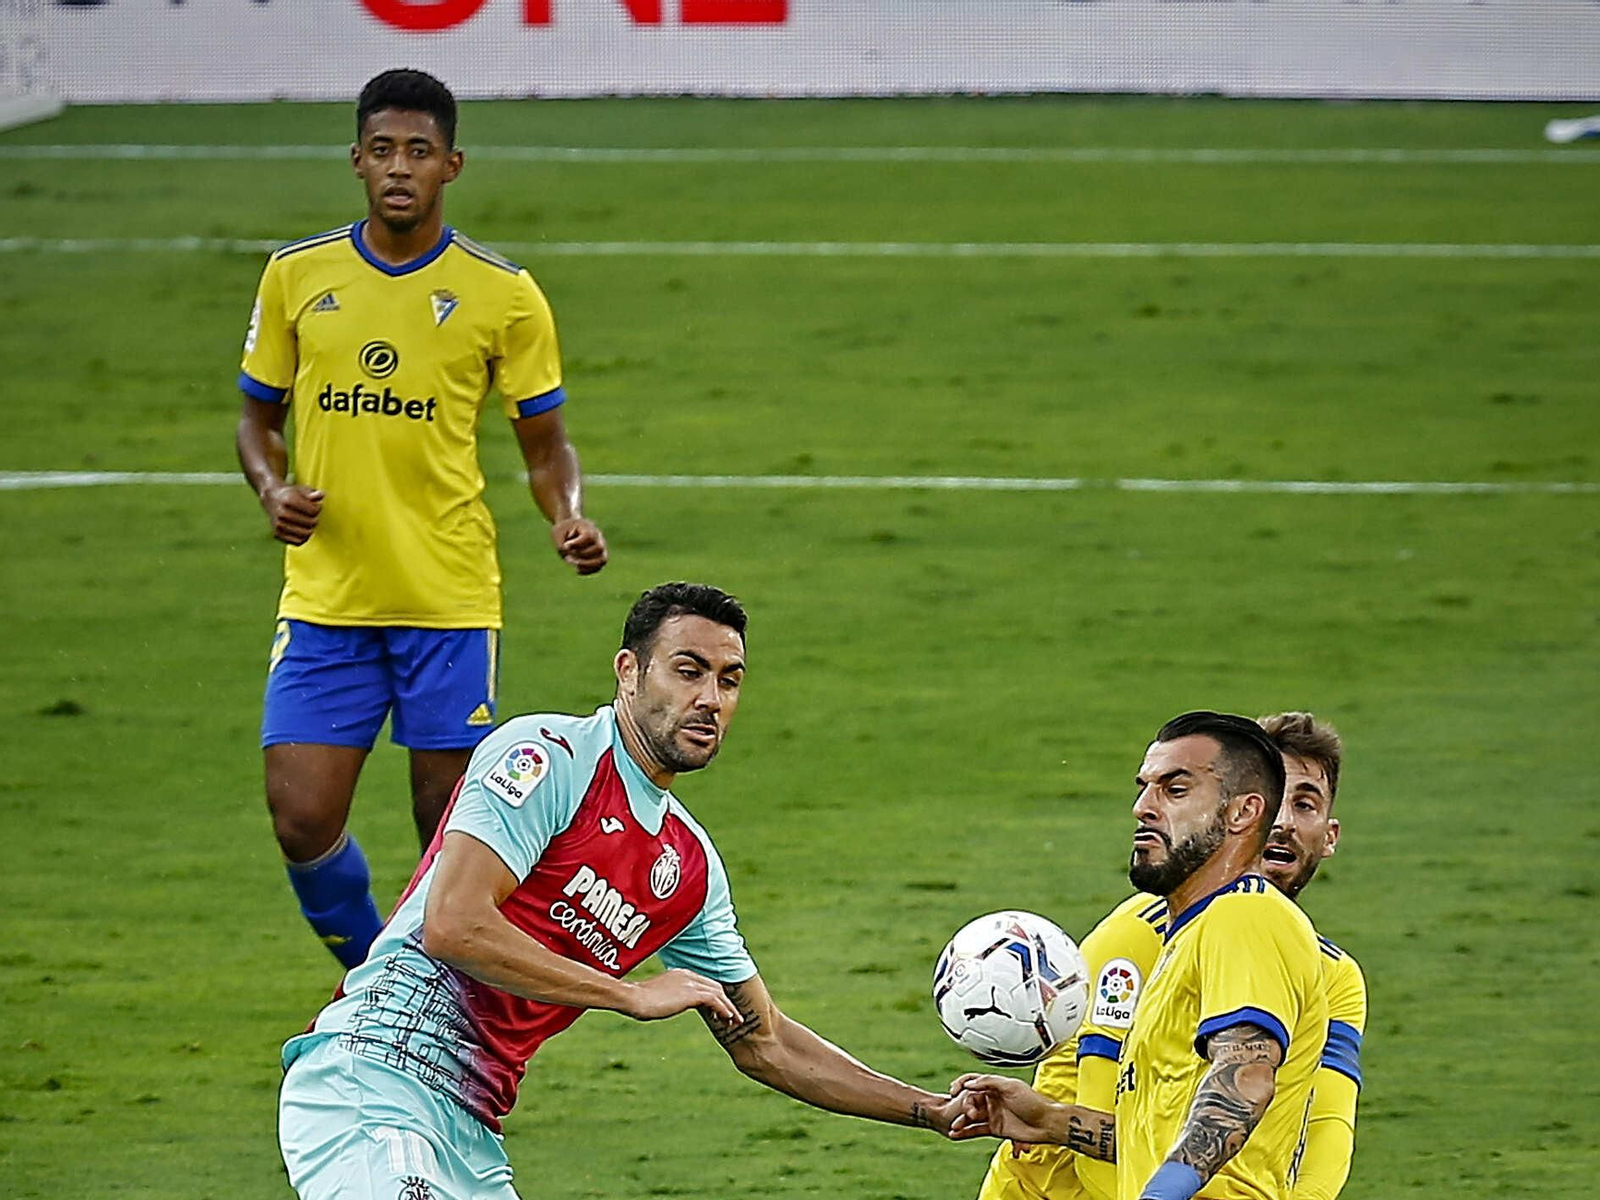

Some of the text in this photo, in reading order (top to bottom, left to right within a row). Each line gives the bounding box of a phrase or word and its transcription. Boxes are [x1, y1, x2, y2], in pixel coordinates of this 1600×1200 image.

[318, 382, 437, 422] dafabet
[490, 771, 523, 799] LaLiga
[562, 865, 651, 949] PAMESA
